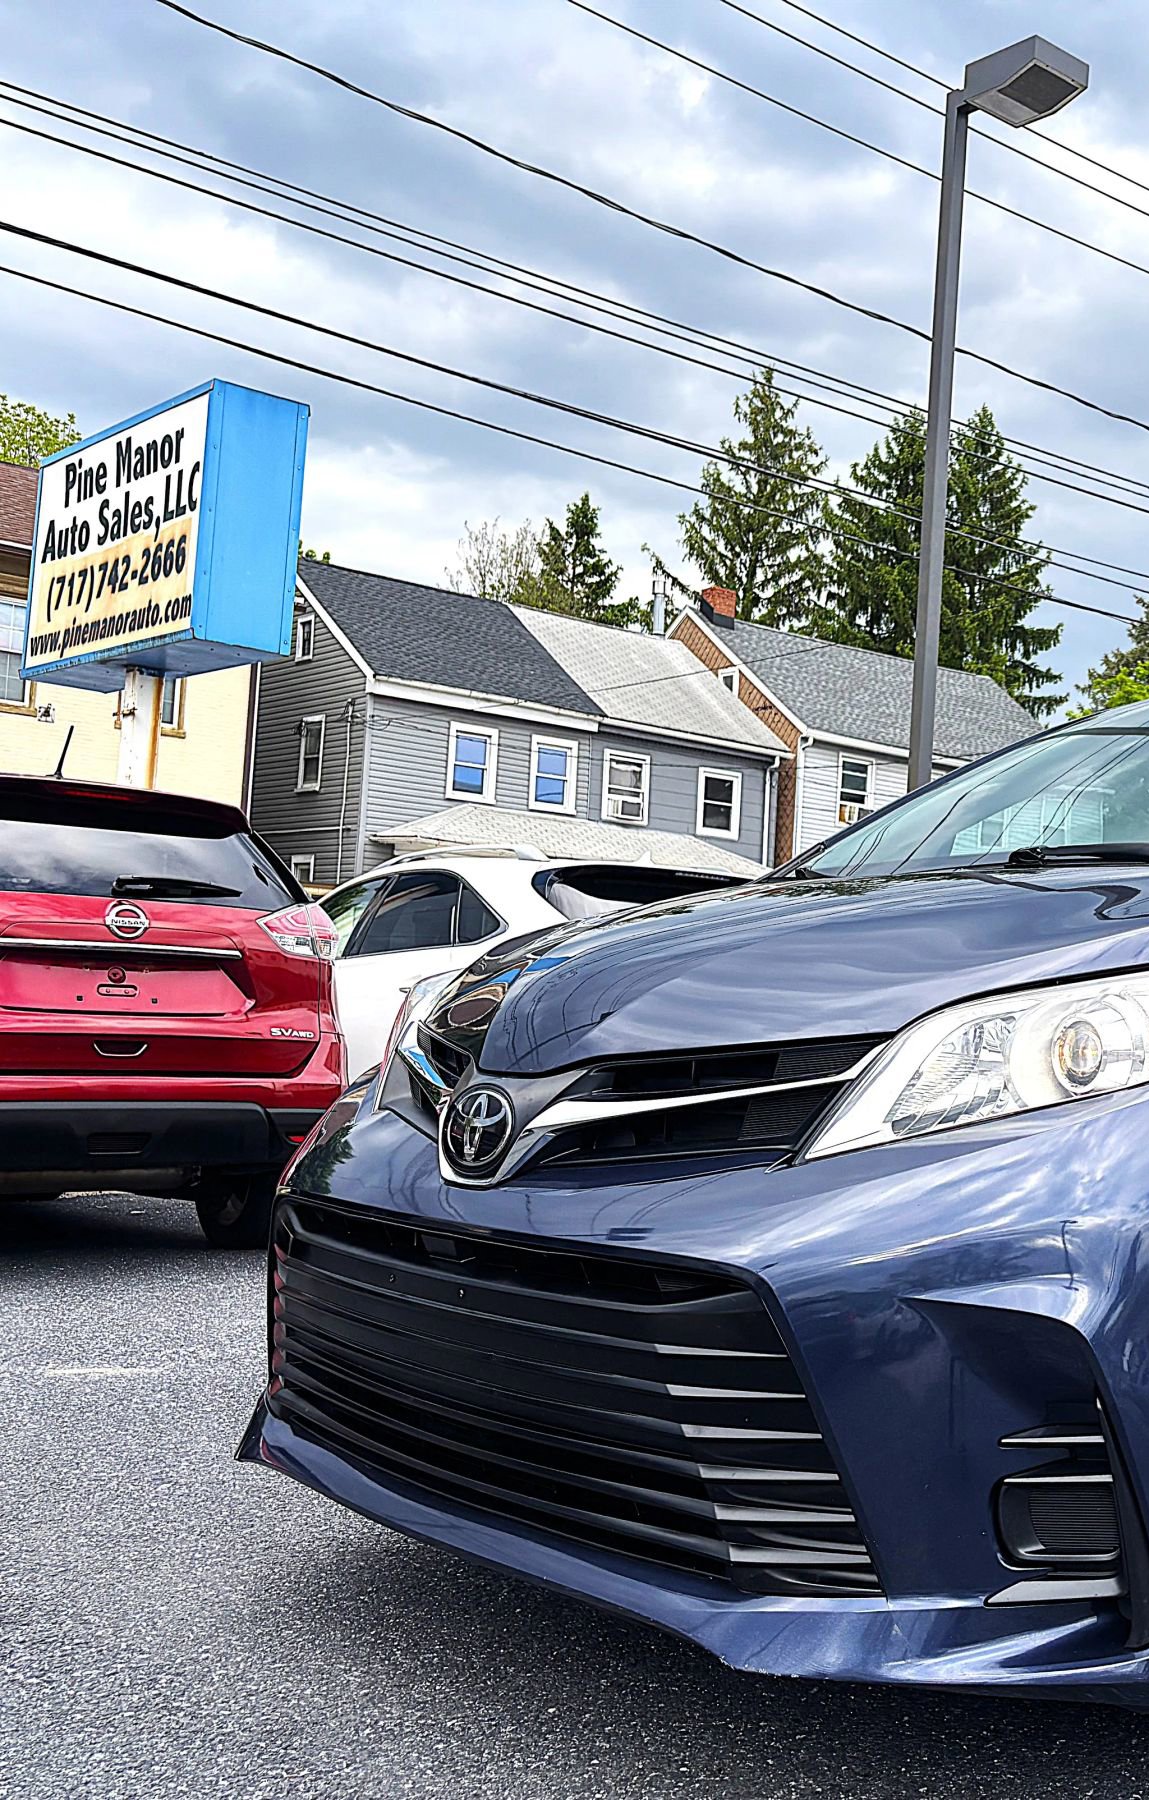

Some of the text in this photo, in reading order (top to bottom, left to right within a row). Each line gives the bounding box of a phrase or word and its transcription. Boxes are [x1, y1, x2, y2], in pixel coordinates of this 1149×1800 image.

[65, 427, 184, 508] Pine Manor
[41, 516, 90, 564] Auto
[46, 534, 187, 622] (717)742-2666
[30, 593, 192, 658] www.pinemanorauto.com
